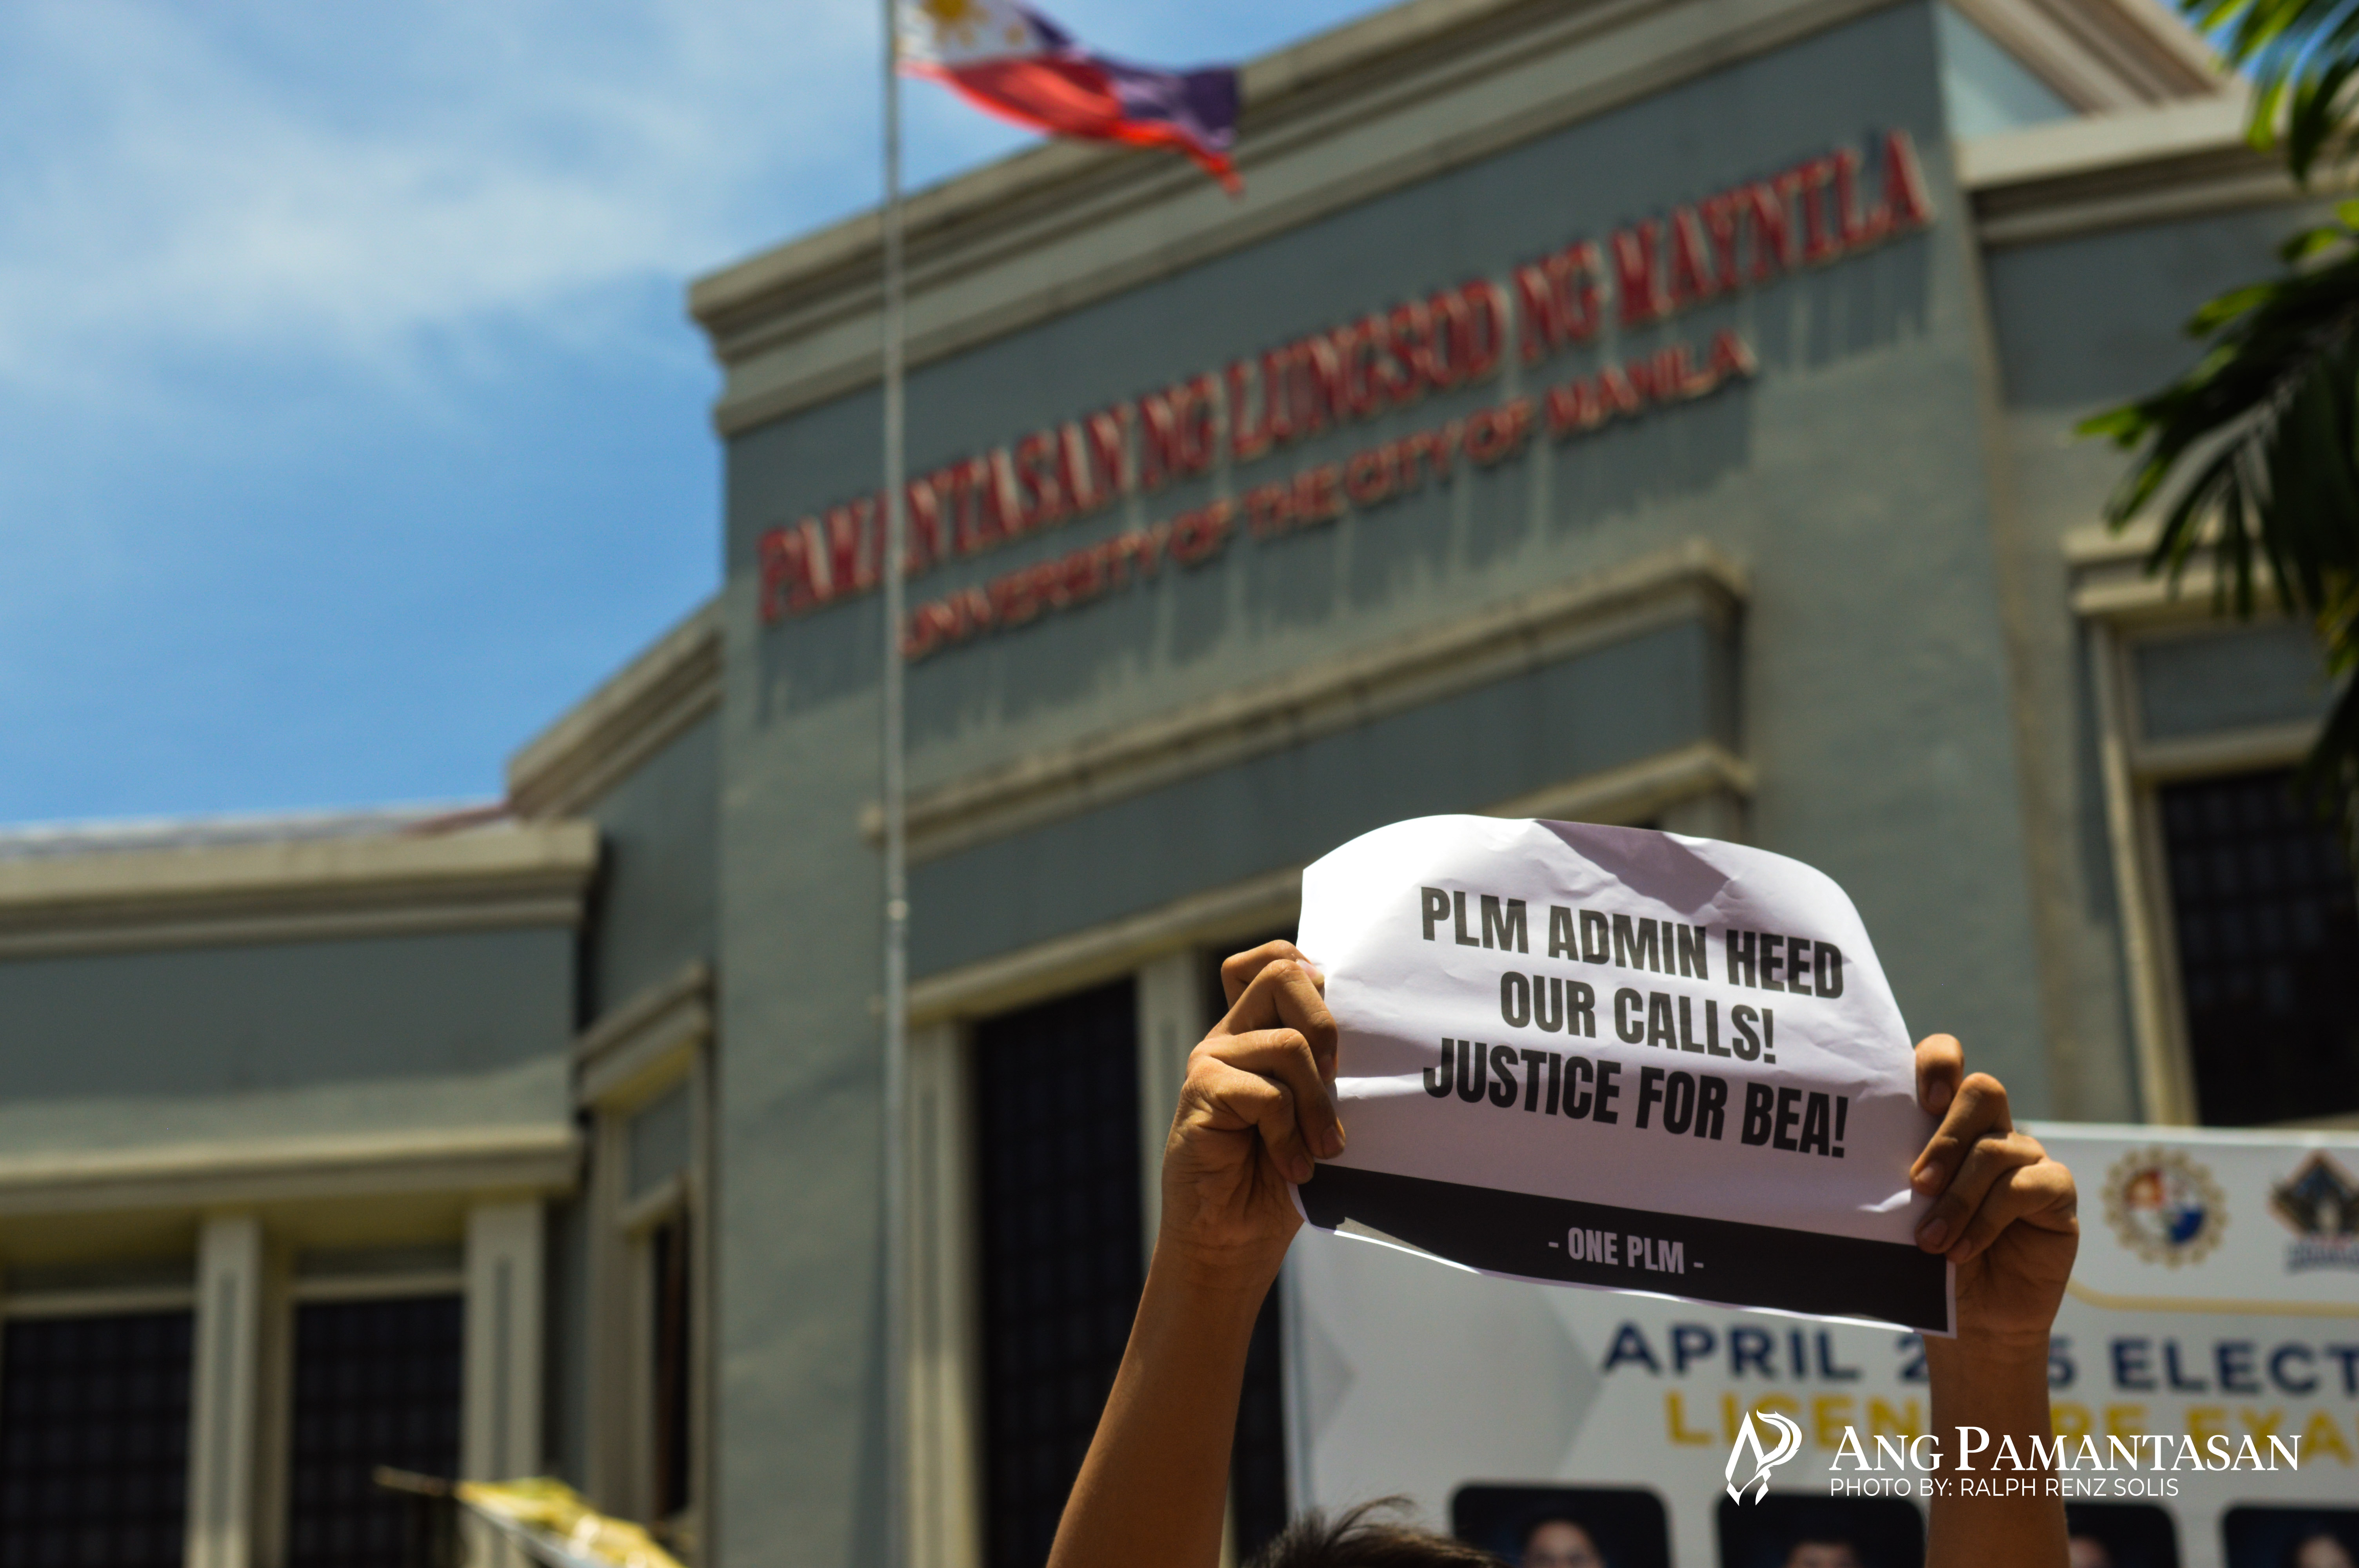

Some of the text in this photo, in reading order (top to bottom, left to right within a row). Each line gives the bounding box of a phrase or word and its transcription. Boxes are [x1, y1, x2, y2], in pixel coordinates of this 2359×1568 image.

[1420, 887, 1844, 999] PLM ADMIN HEED
[1500, 971, 1777, 1065] OUR CALLS!
[1423, 1038, 1849, 1159] JUSTICE FOR BEA!
[1568, 1227, 1619, 1265] ONE
[1627, 1235, 1685, 1274] PLM
[1601, 1319, 1863, 1383] APRIL
[1896, 1332, 2076, 1390] 25
[1664, 1389, 2359, 1469] LICENRE EXA
